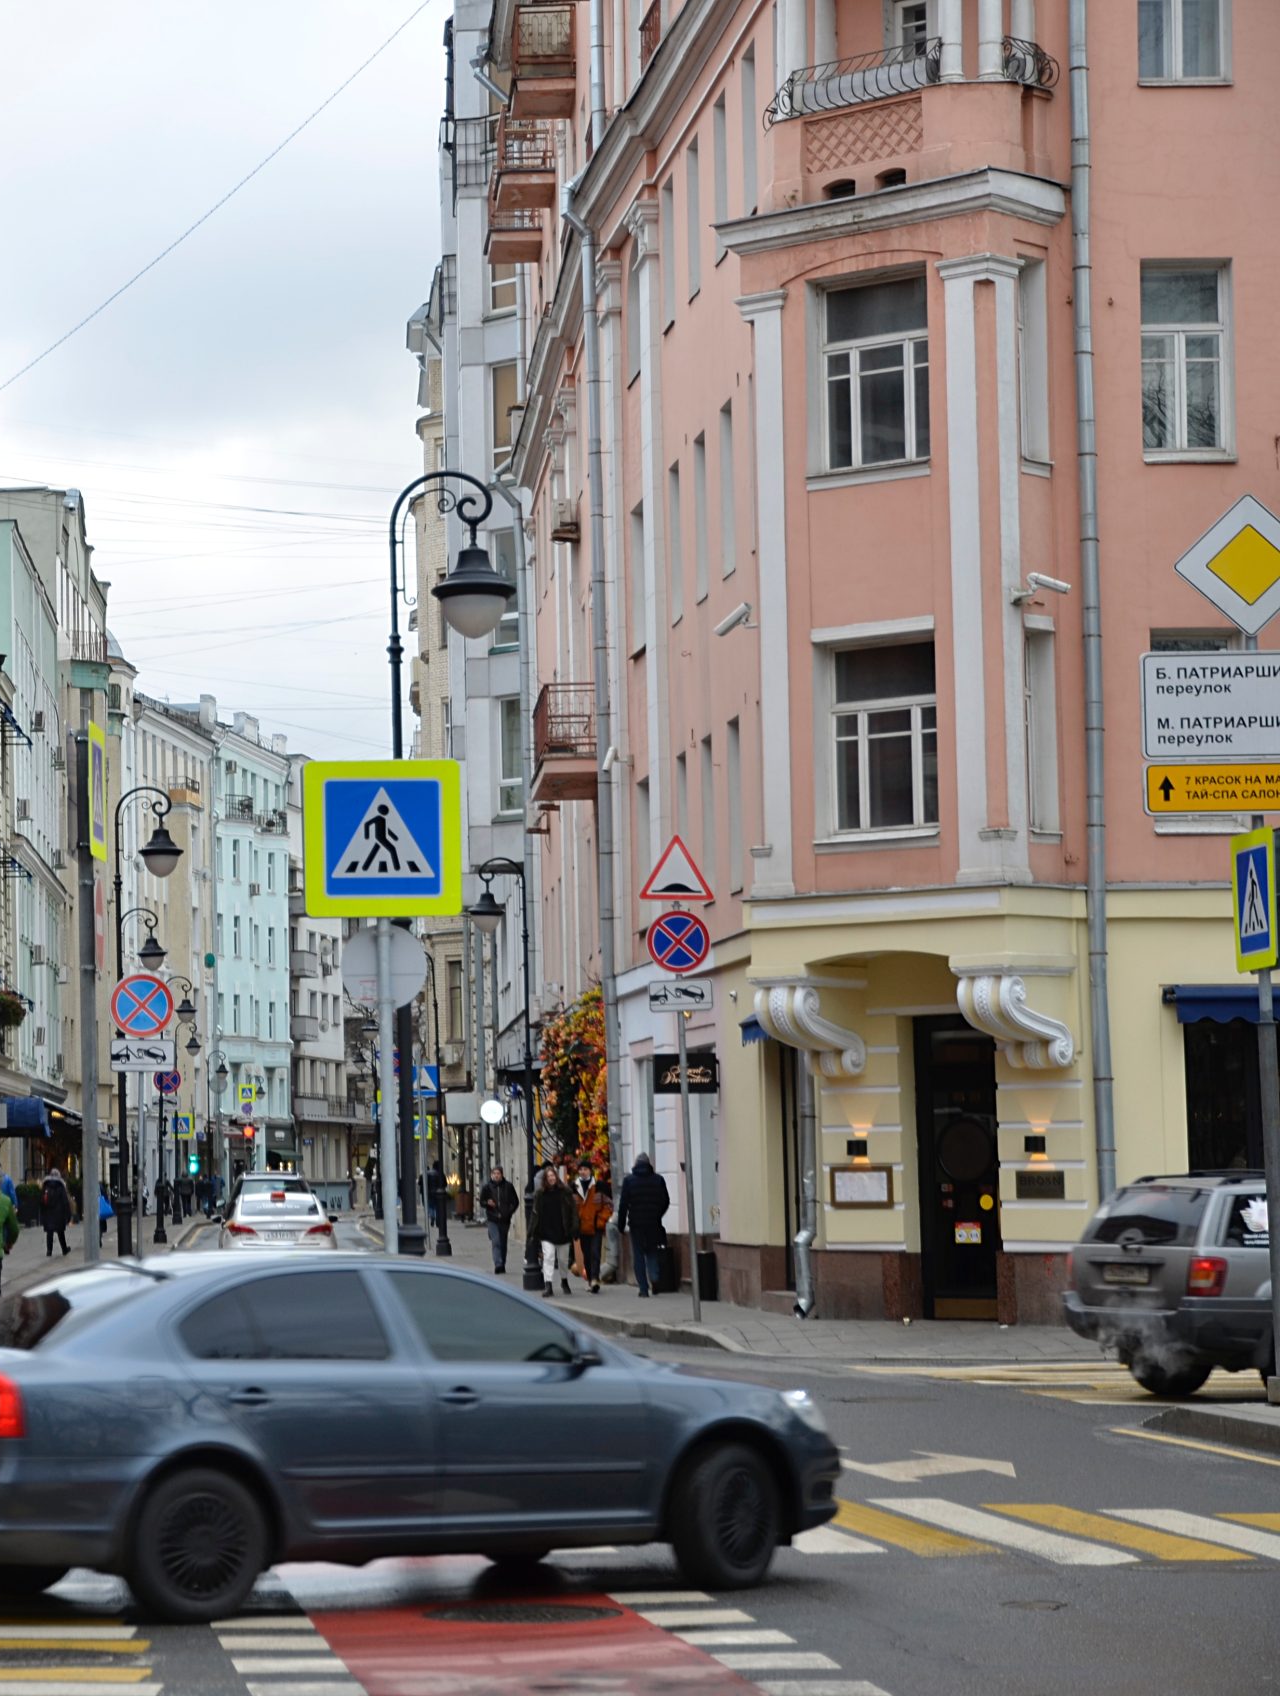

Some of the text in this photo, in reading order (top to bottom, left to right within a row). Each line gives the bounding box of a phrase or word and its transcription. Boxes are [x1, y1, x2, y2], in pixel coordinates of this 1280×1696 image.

[1156, 667, 1172, 680] Б.
[1156, 684, 1232, 696] переулок
[1157, 717, 1175, 730] М.
[1158, 734, 1233, 746] переулок
[1185, 776, 1192, 785] 7
[1195, 775, 1241, 786] КРАСОК
[1244, 775, 1262, 784] НА
[1185, 789, 1238, 800] ТАЙ-СПА
